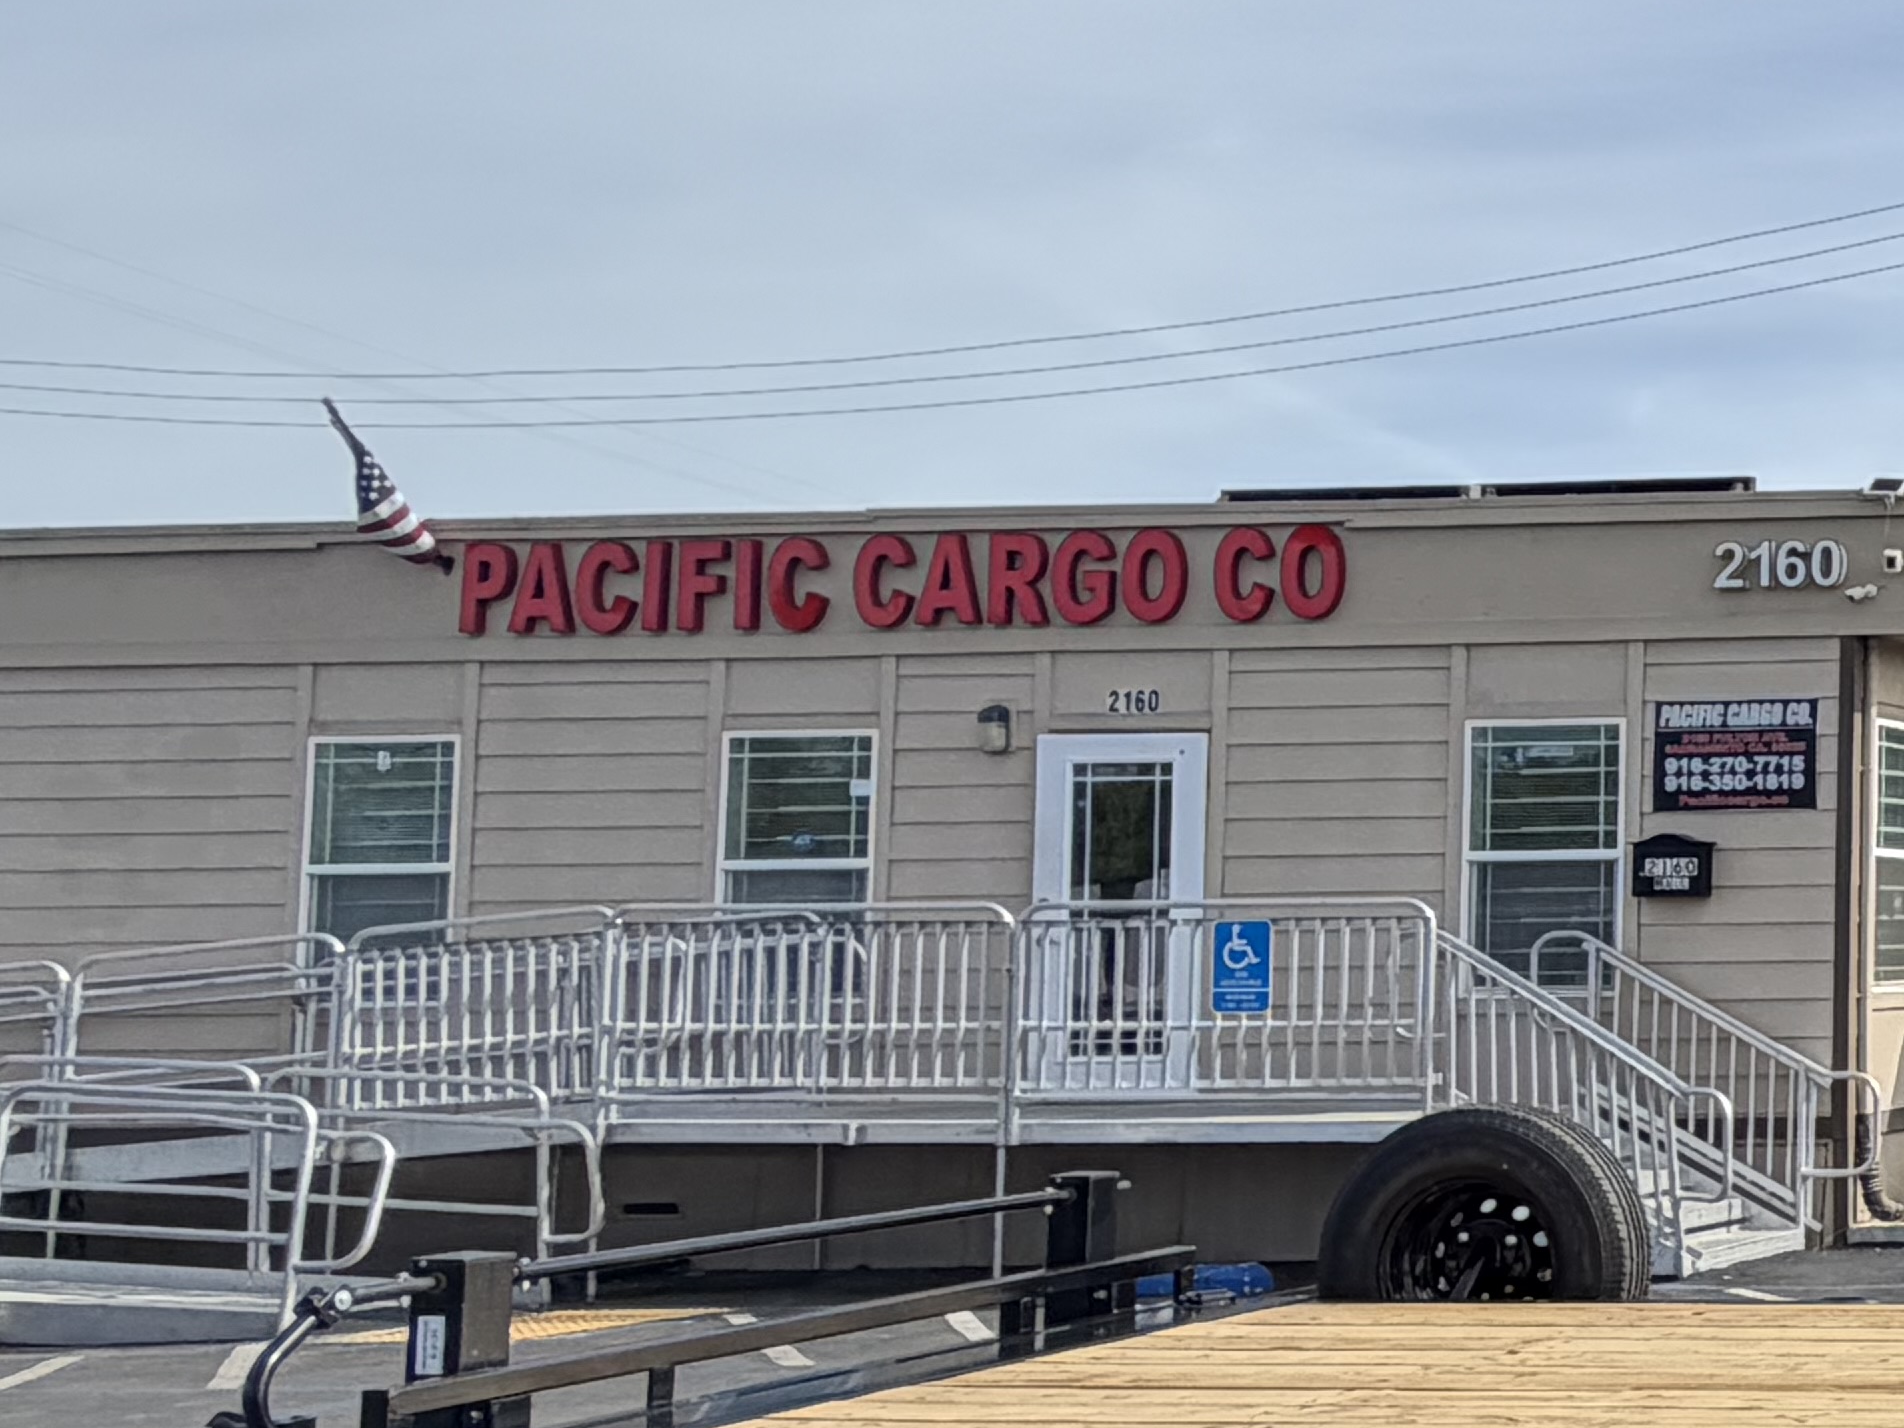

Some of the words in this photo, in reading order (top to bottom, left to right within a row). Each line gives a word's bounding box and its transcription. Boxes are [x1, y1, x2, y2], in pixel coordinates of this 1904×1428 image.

[1713, 539, 1846, 589] 2160
[458, 535, 831, 636] PACIFIC
[853, 526, 1190, 629] CARGO
[1213, 523, 1347, 624] CO
[1108, 689, 1160, 713] 2160
[1664, 755, 1806, 775] 916-270-7715
[1664, 773, 1806, 792] 916-350-1819
[1647, 858, 1697, 875] 2160
